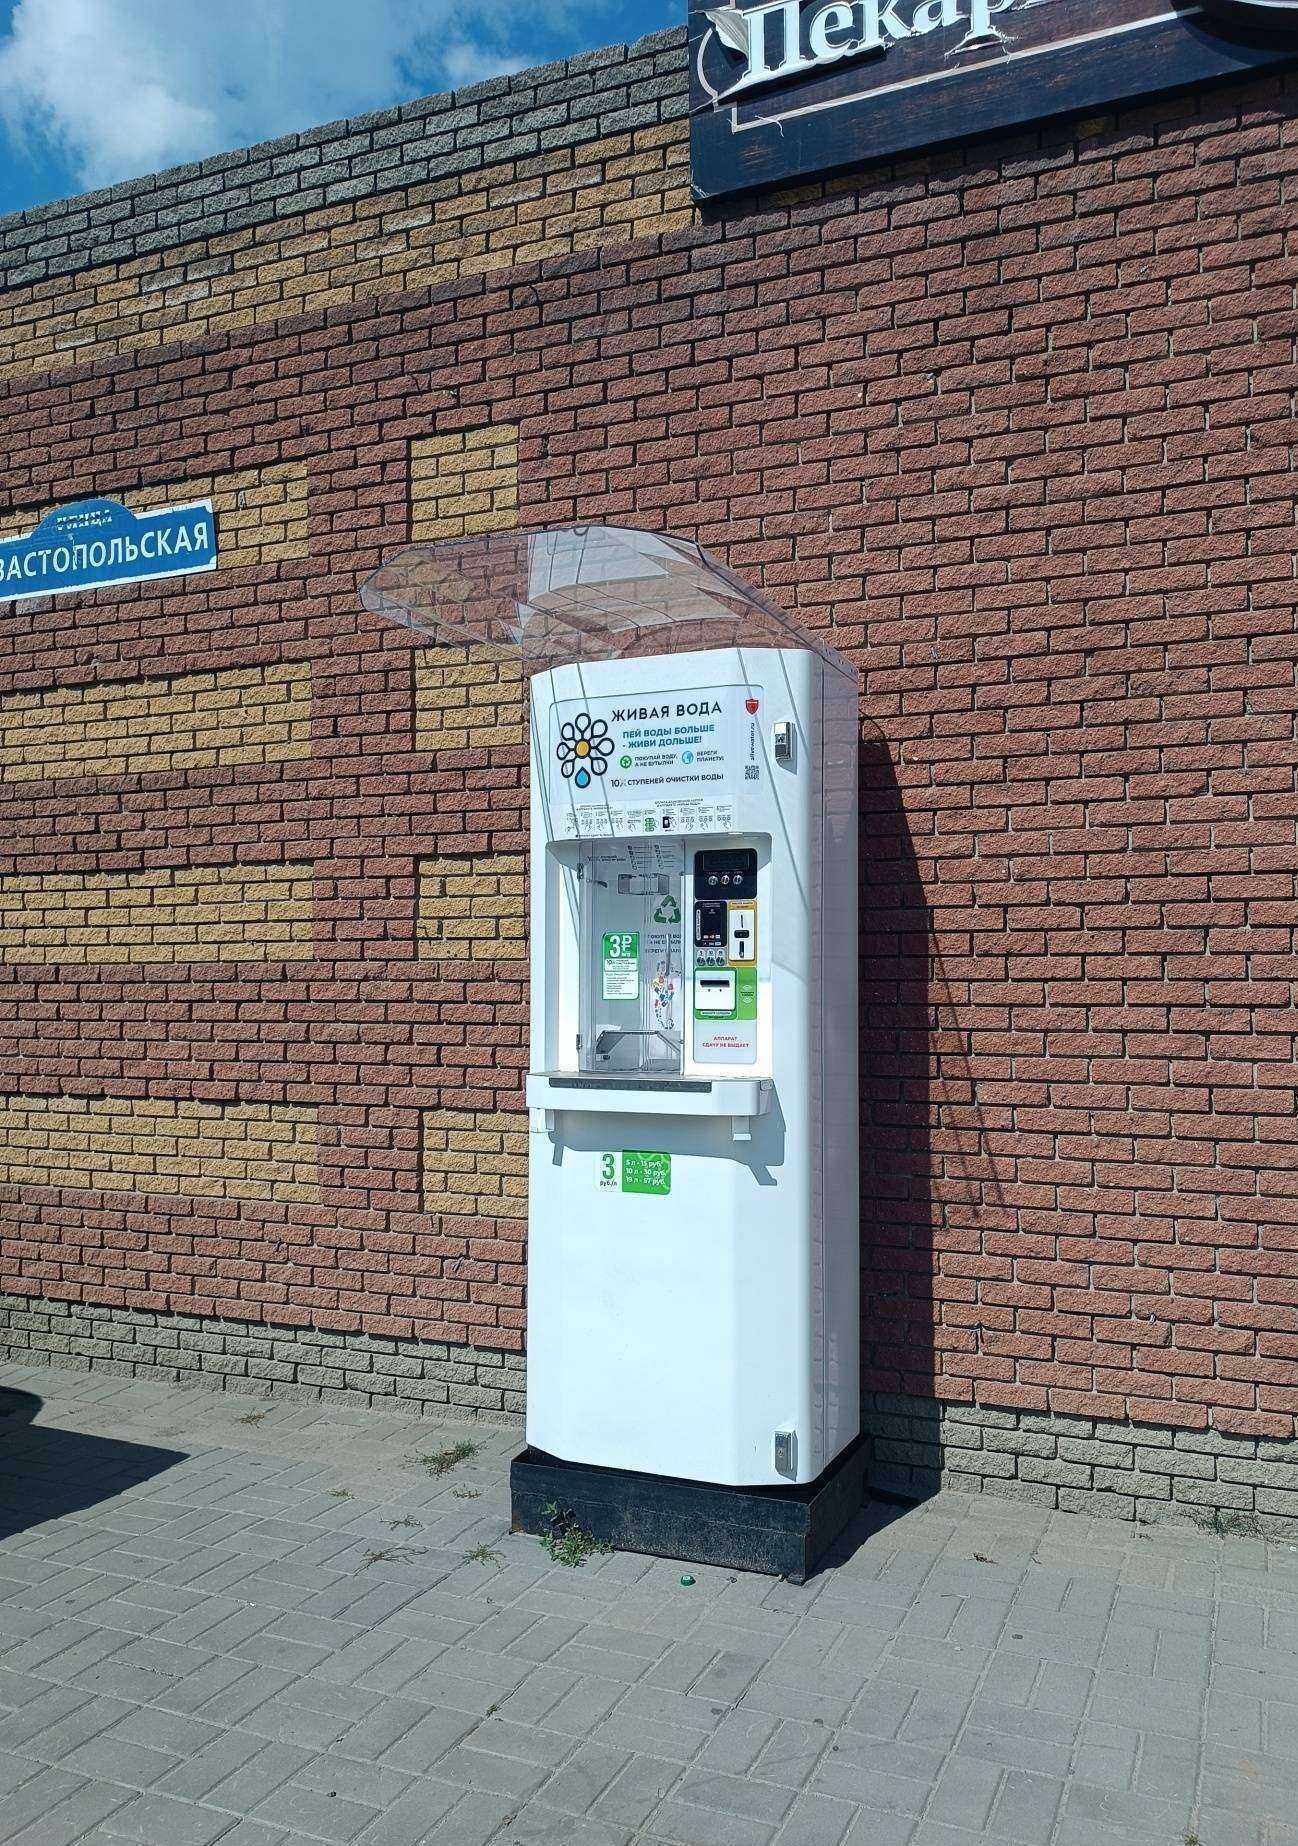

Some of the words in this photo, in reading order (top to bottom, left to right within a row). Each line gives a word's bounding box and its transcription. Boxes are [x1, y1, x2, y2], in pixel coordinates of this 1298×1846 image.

[737, 0, 1040, 80] Пекар
[611, 705, 670, 722] ЖИВАЯ
[676, 701, 722, 717] ВОДА
[623, 729, 641, 739] ПЕЙ
[643, 728, 671, 738] ВОДЫ
[674, 724, 715, 735] БОЛЬШЕ
[628, 740, 656, 749] ЖИВИ
[658, 736, 702, 748] ДОЛЬШЕ!
[627, 777, 664, 786] СТУПЕНЕЙ
[665, 775, 700, 784] ОЧИСТКИ
[701, 773, 724, 781] ВОДЫ
[602, 1153, 615, 1179] 3
